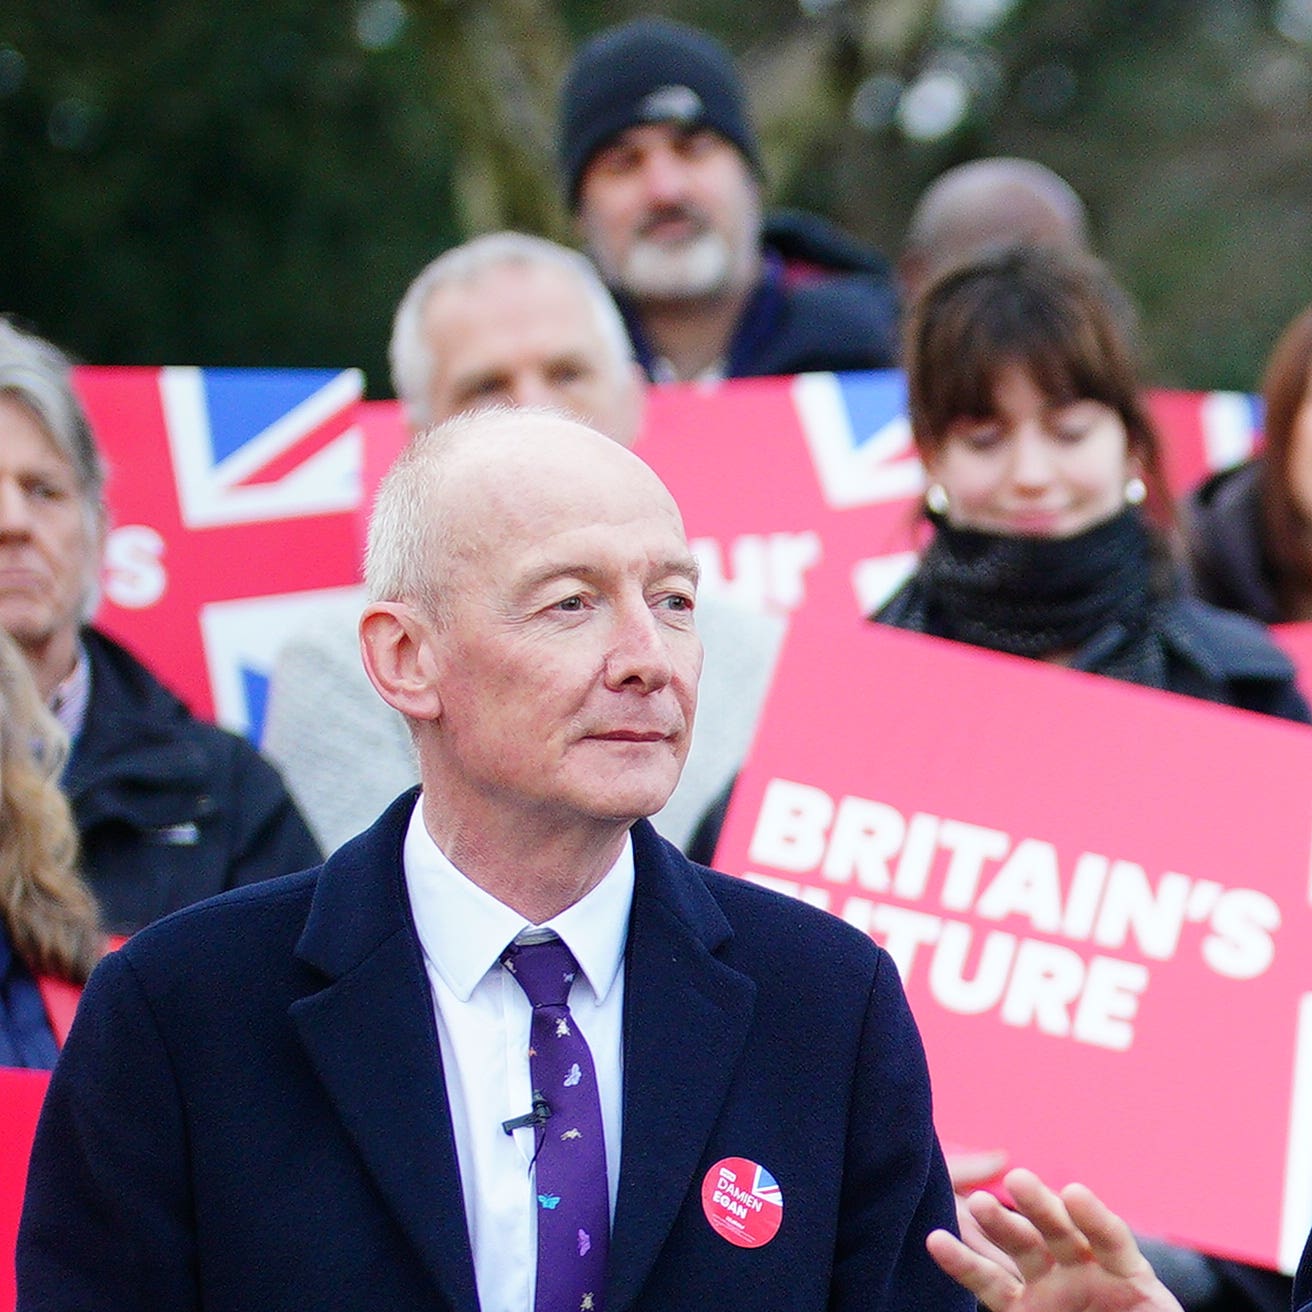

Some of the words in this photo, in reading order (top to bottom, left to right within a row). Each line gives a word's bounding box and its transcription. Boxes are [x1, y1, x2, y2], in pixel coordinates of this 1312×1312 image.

[746, 776, 1283, 980] BRITAIN'S
[741, 871, 1151, 1053] TURE
[712, 1190, 748, 1219] EGAN
[717, 1176, 763, 1213] DAMIEN
